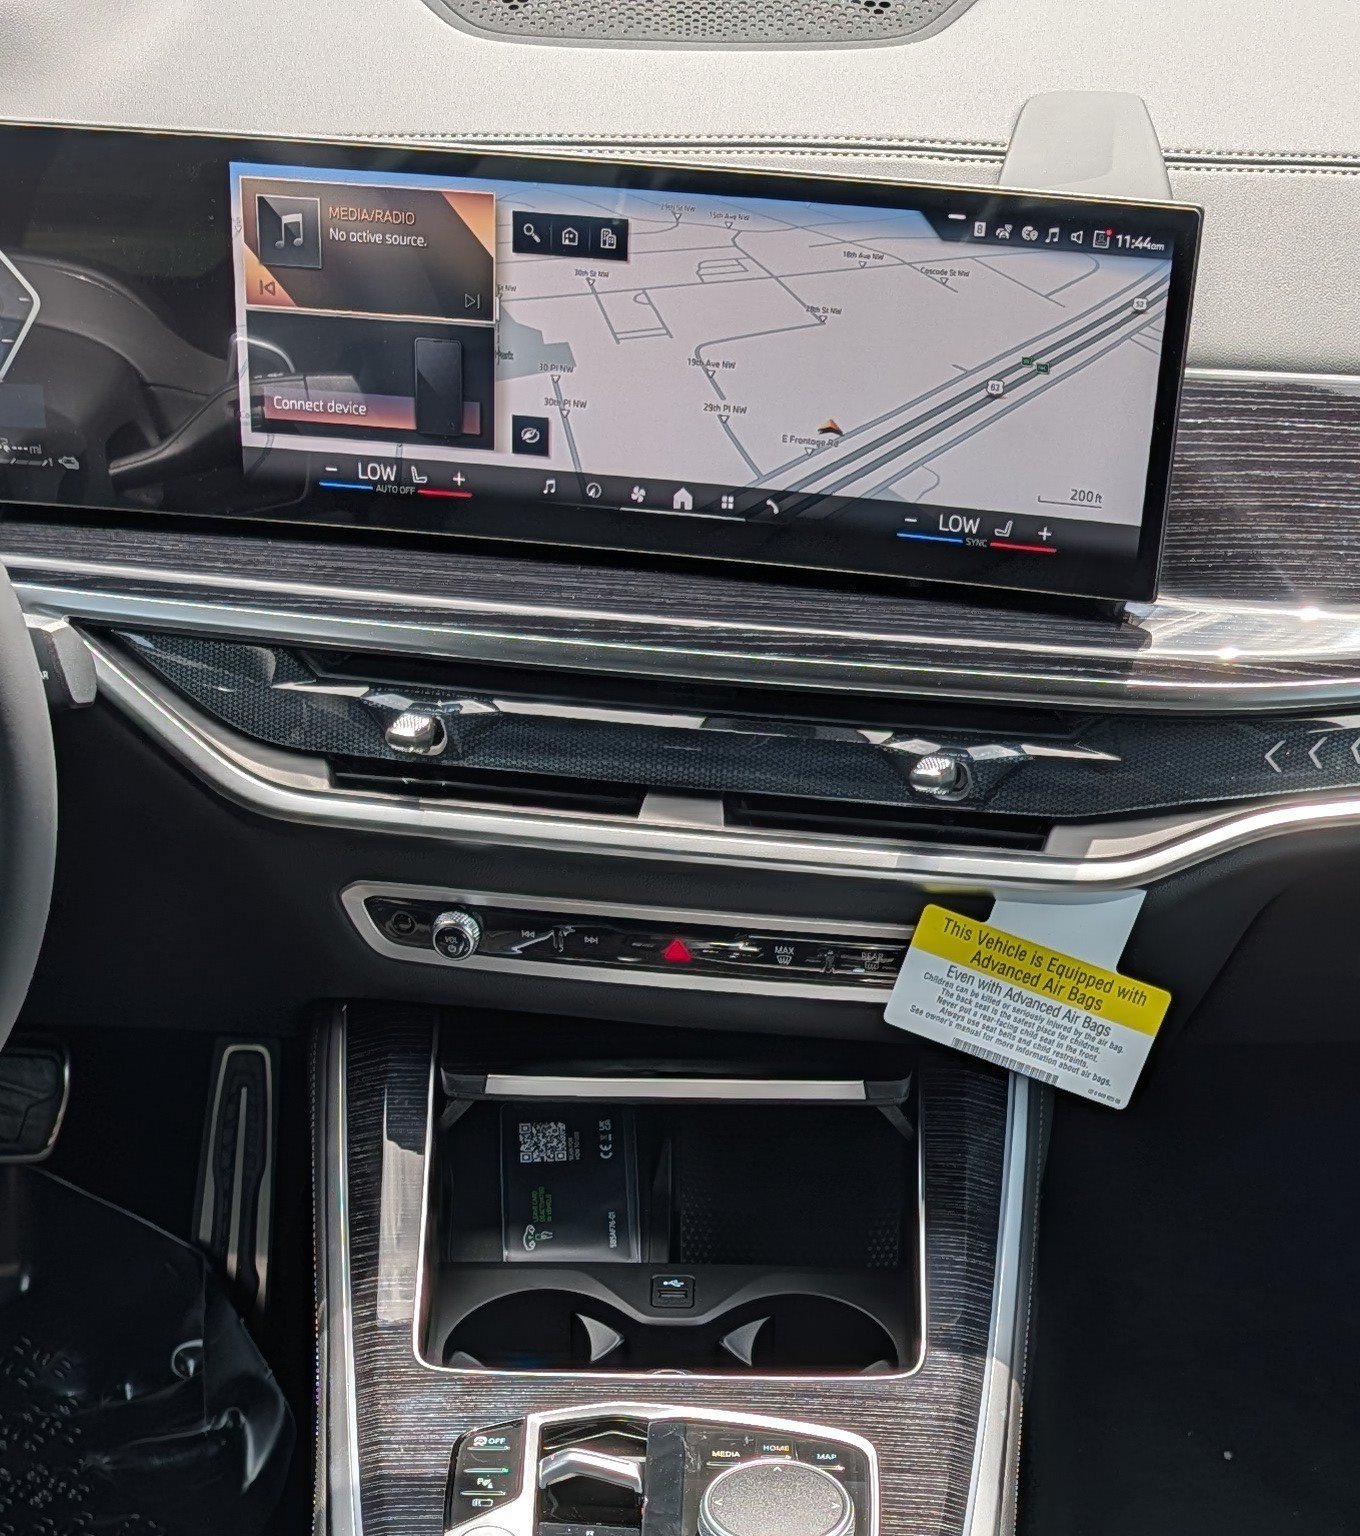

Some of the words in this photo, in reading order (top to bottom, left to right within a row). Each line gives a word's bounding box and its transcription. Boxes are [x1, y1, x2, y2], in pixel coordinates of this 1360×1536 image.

[328, 206, 416, 226] MEDIA/RADIO
[329, 227, 346, 242] No
[349, 229, 383, 244] active
[386, 232, 428, 247] source.
[920, 266, 948, 276] Cascade
[949, 268, 957, 277] St
[821, 306, 830, 315] St
[830, 307, 843, 316] NW
[559, 365, 575, 373] NW
[705, 359, 721, 369] Ave
[721, 360, 737, 370] NW
[273, 395, 325, 413] Connect
[327, 400, 368, 416] device
[572, 400, 588, 409] NW
[702, 402, 721, 413] 29th
[731, 406, 748, 415] NW
[781, 434, 789, 443] E
[789, 435, 826, 447] Frontage
[358, 461, 397, 482] LOW
[375, 484, 399, 495] AUTO
[399, 486, 416, 496] OFF
[1070, 488, 1094, 503] 200
[939, 513, 981, 535] LOW
[966, 536, 988, 548] SYNC
[774, 945, 795, 956] MAX
[861, 951, 884, 961] REAR
[943, 917, 972, 941] This
[978, 929, 1027, 961] Vehicle
[1029, 950, 1043, 968] is
[1046, 956, 1115, 993] Equipped
[1117, 986, 1147, 1006] with
[969, 950, 1042, 988] Advanced
[1041, 977, 1066, 996] Air
[1067, 985, 1103, 1014] Bags
[946, 964, 975, 986] Even
[977, 978, 1002, 996] with
[1003, 987, 1062, 1018] Advanced
[1061, 1008, 1081, 1025] Air
[1081, 1015, 1111, 1040] Bags
[923, 971, 954, 989] Children
[955, 985, 969, 994] can
[980, 993, 1002, 1007] killed
[1011, 1006, 1045, 1025] seriously
[1046, 1017, 1073, 1033] injured
[1084, 1032, 1098, 1043] the
[1097, 1038, 1108, 1046] air
[1108, 1041, 1123, 1054] bag.
[941, 987, 954, 999] The
[955, 993, 973, 1006] back
[974, 1001, 990, 1012] seat
[999, 1010, 1012, 1020] the
[1012, 1016, 1036, 1029] safest
[1035, 1024, 1056, 1037] place
[1057, 1031, 1069, 1041] for
[1069, 1037, 1100, 1054] children.
[936, 995, 958, 1009] Never
[958, 1005, 972, 1015] put
[979, 1013, 1019, 1034] rear-facing
[1019, 1028, 1039, 1040] child
[1039, 1035, 1055, 1046] seat
[1065, 1044, 1077, 1054] the
[1078, 1048, 1097, 1063] front.
[939, 1007, 965, 1022] Always
[966, 1018, 980, 1027] use
[981, 1023, 997, 1034] seat
[998, 1028, 1016, 1041] belts
[1017, 1037, 1032, 1047] and
[1032, 1042, 1051, 1054] child
[1052, 1050, 1088, 1068] restraints.
[909, 1004, 924, 1016] See
[925, 1011, 953, 1027] owner's
[954, 1020, 982, 1037] manual
[982, 1031, 994, 1042] for
[994, 1037, 1014, 1050] more
[1015, 1044, 1057, 1066] information
[1058, 1062, 1080, 1075] about
[1080, 1070, 1091, 1078] air
[1092, 1073, 1111, 1086] bags.
[488, 1437, 506, 1445] OFF
[711, 1450, 741, 1458] MEDIA
[763, 1444, 790, 1452] HOME
[816, 1453, 837, 1461] MAP
